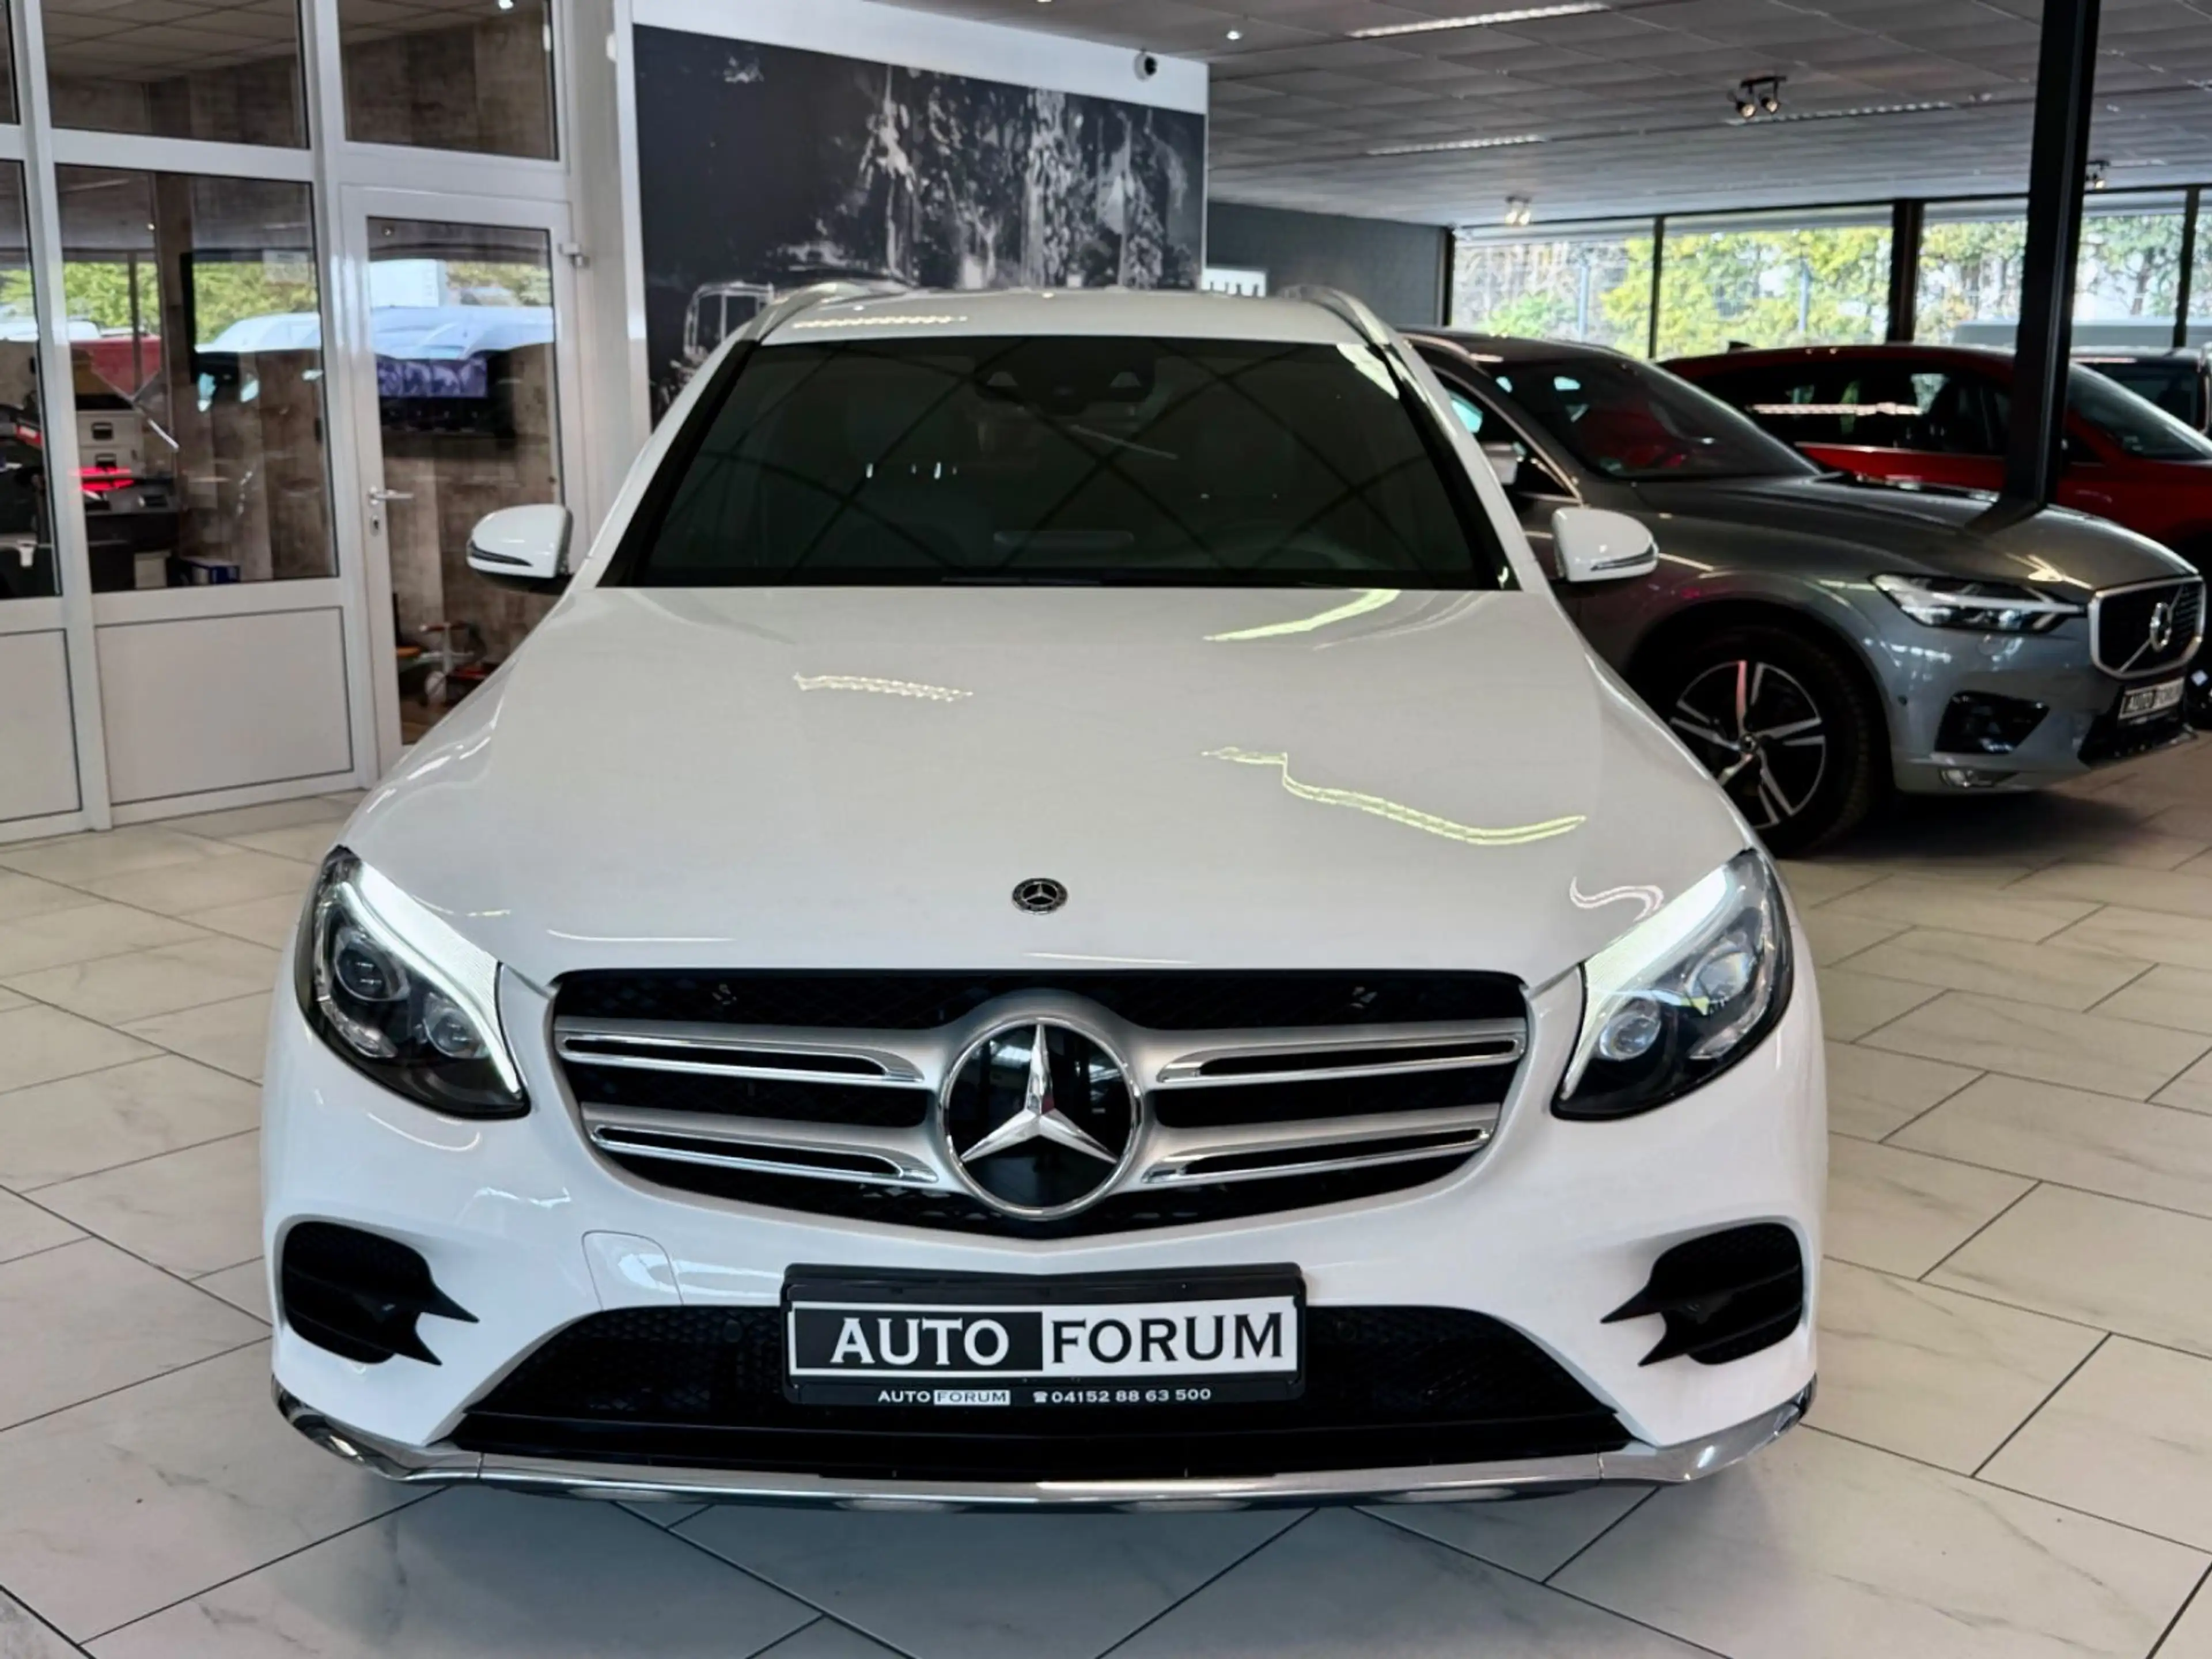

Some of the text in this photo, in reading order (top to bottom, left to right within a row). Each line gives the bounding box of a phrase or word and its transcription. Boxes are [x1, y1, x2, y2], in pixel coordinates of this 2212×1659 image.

[830, 1312, 1284, 1366] AUTO FORUM
[877, 1388, 1211, 1403] AUTO FORUM 04152 88 63 500
